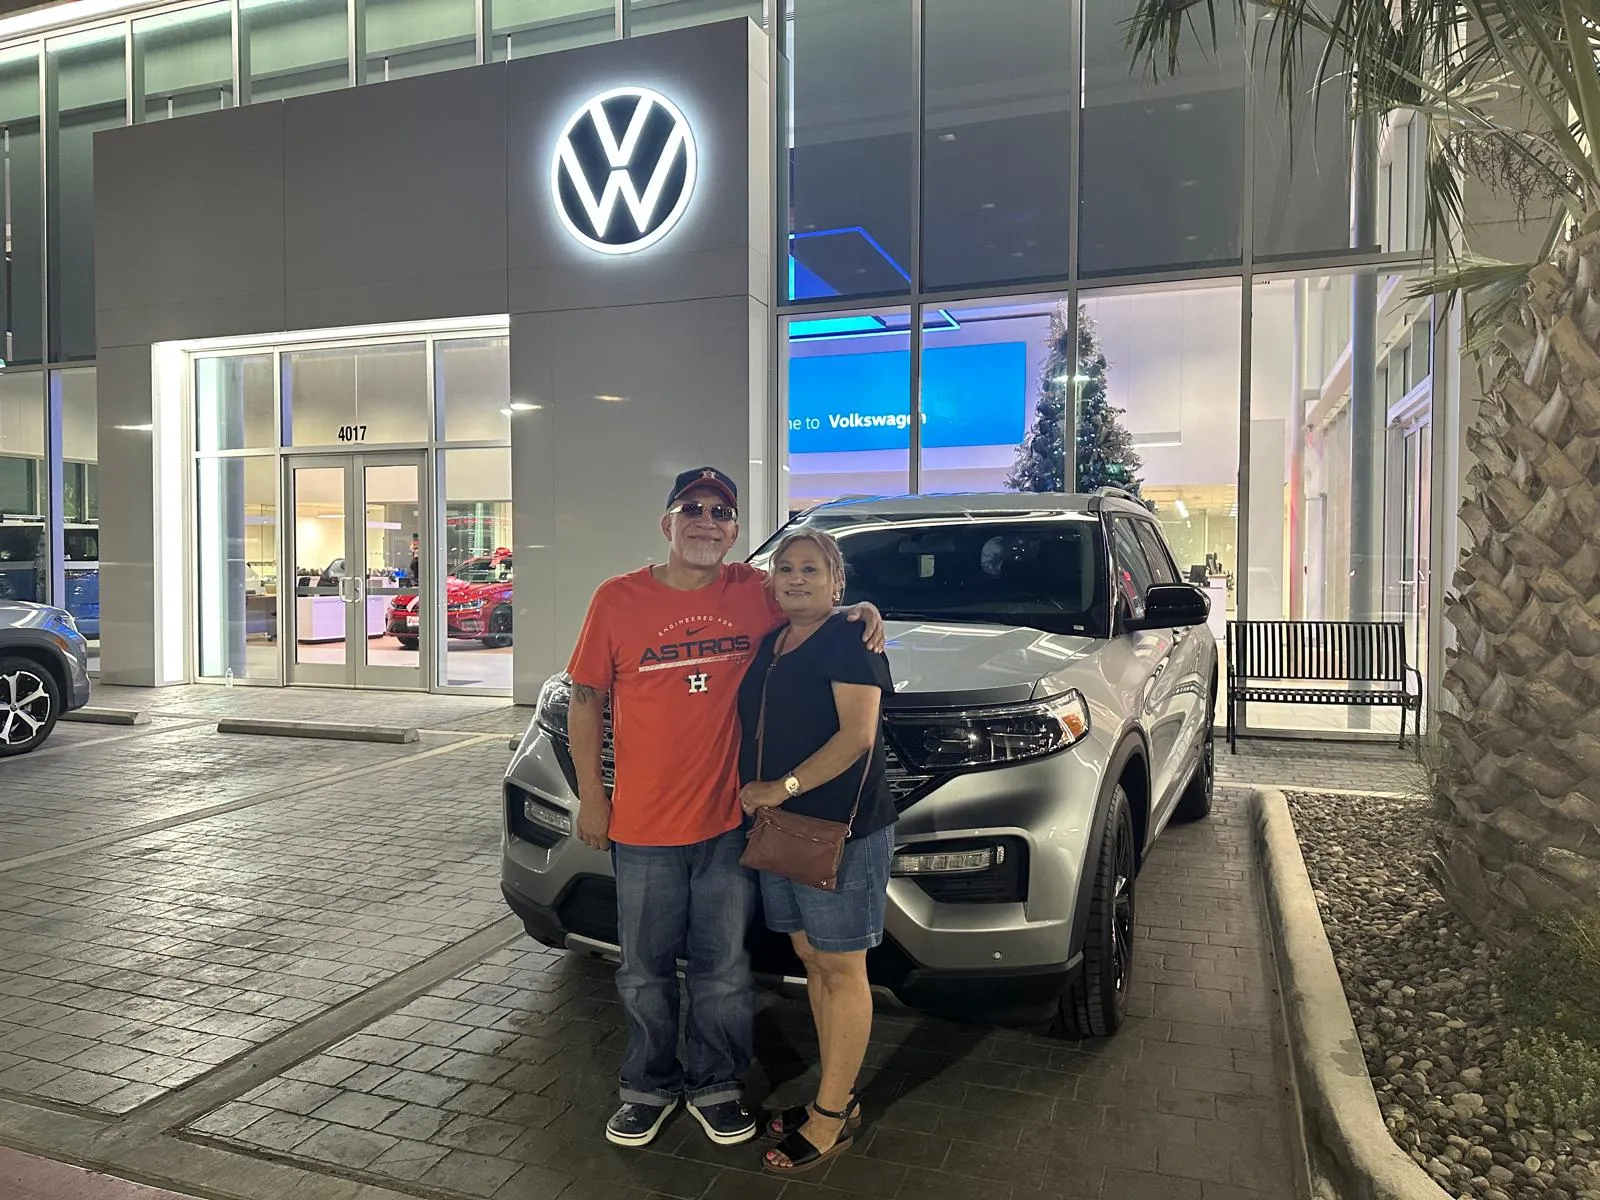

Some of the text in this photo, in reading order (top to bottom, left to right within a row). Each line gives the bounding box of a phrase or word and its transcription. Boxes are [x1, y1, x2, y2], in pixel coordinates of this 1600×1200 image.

[806, 416, 820, 430] to
[338, 425, 367, 441] 4017
[658, 615, 733, 637] ENGINEERED FOR
[640, 635, 750, 663] ASTROS
